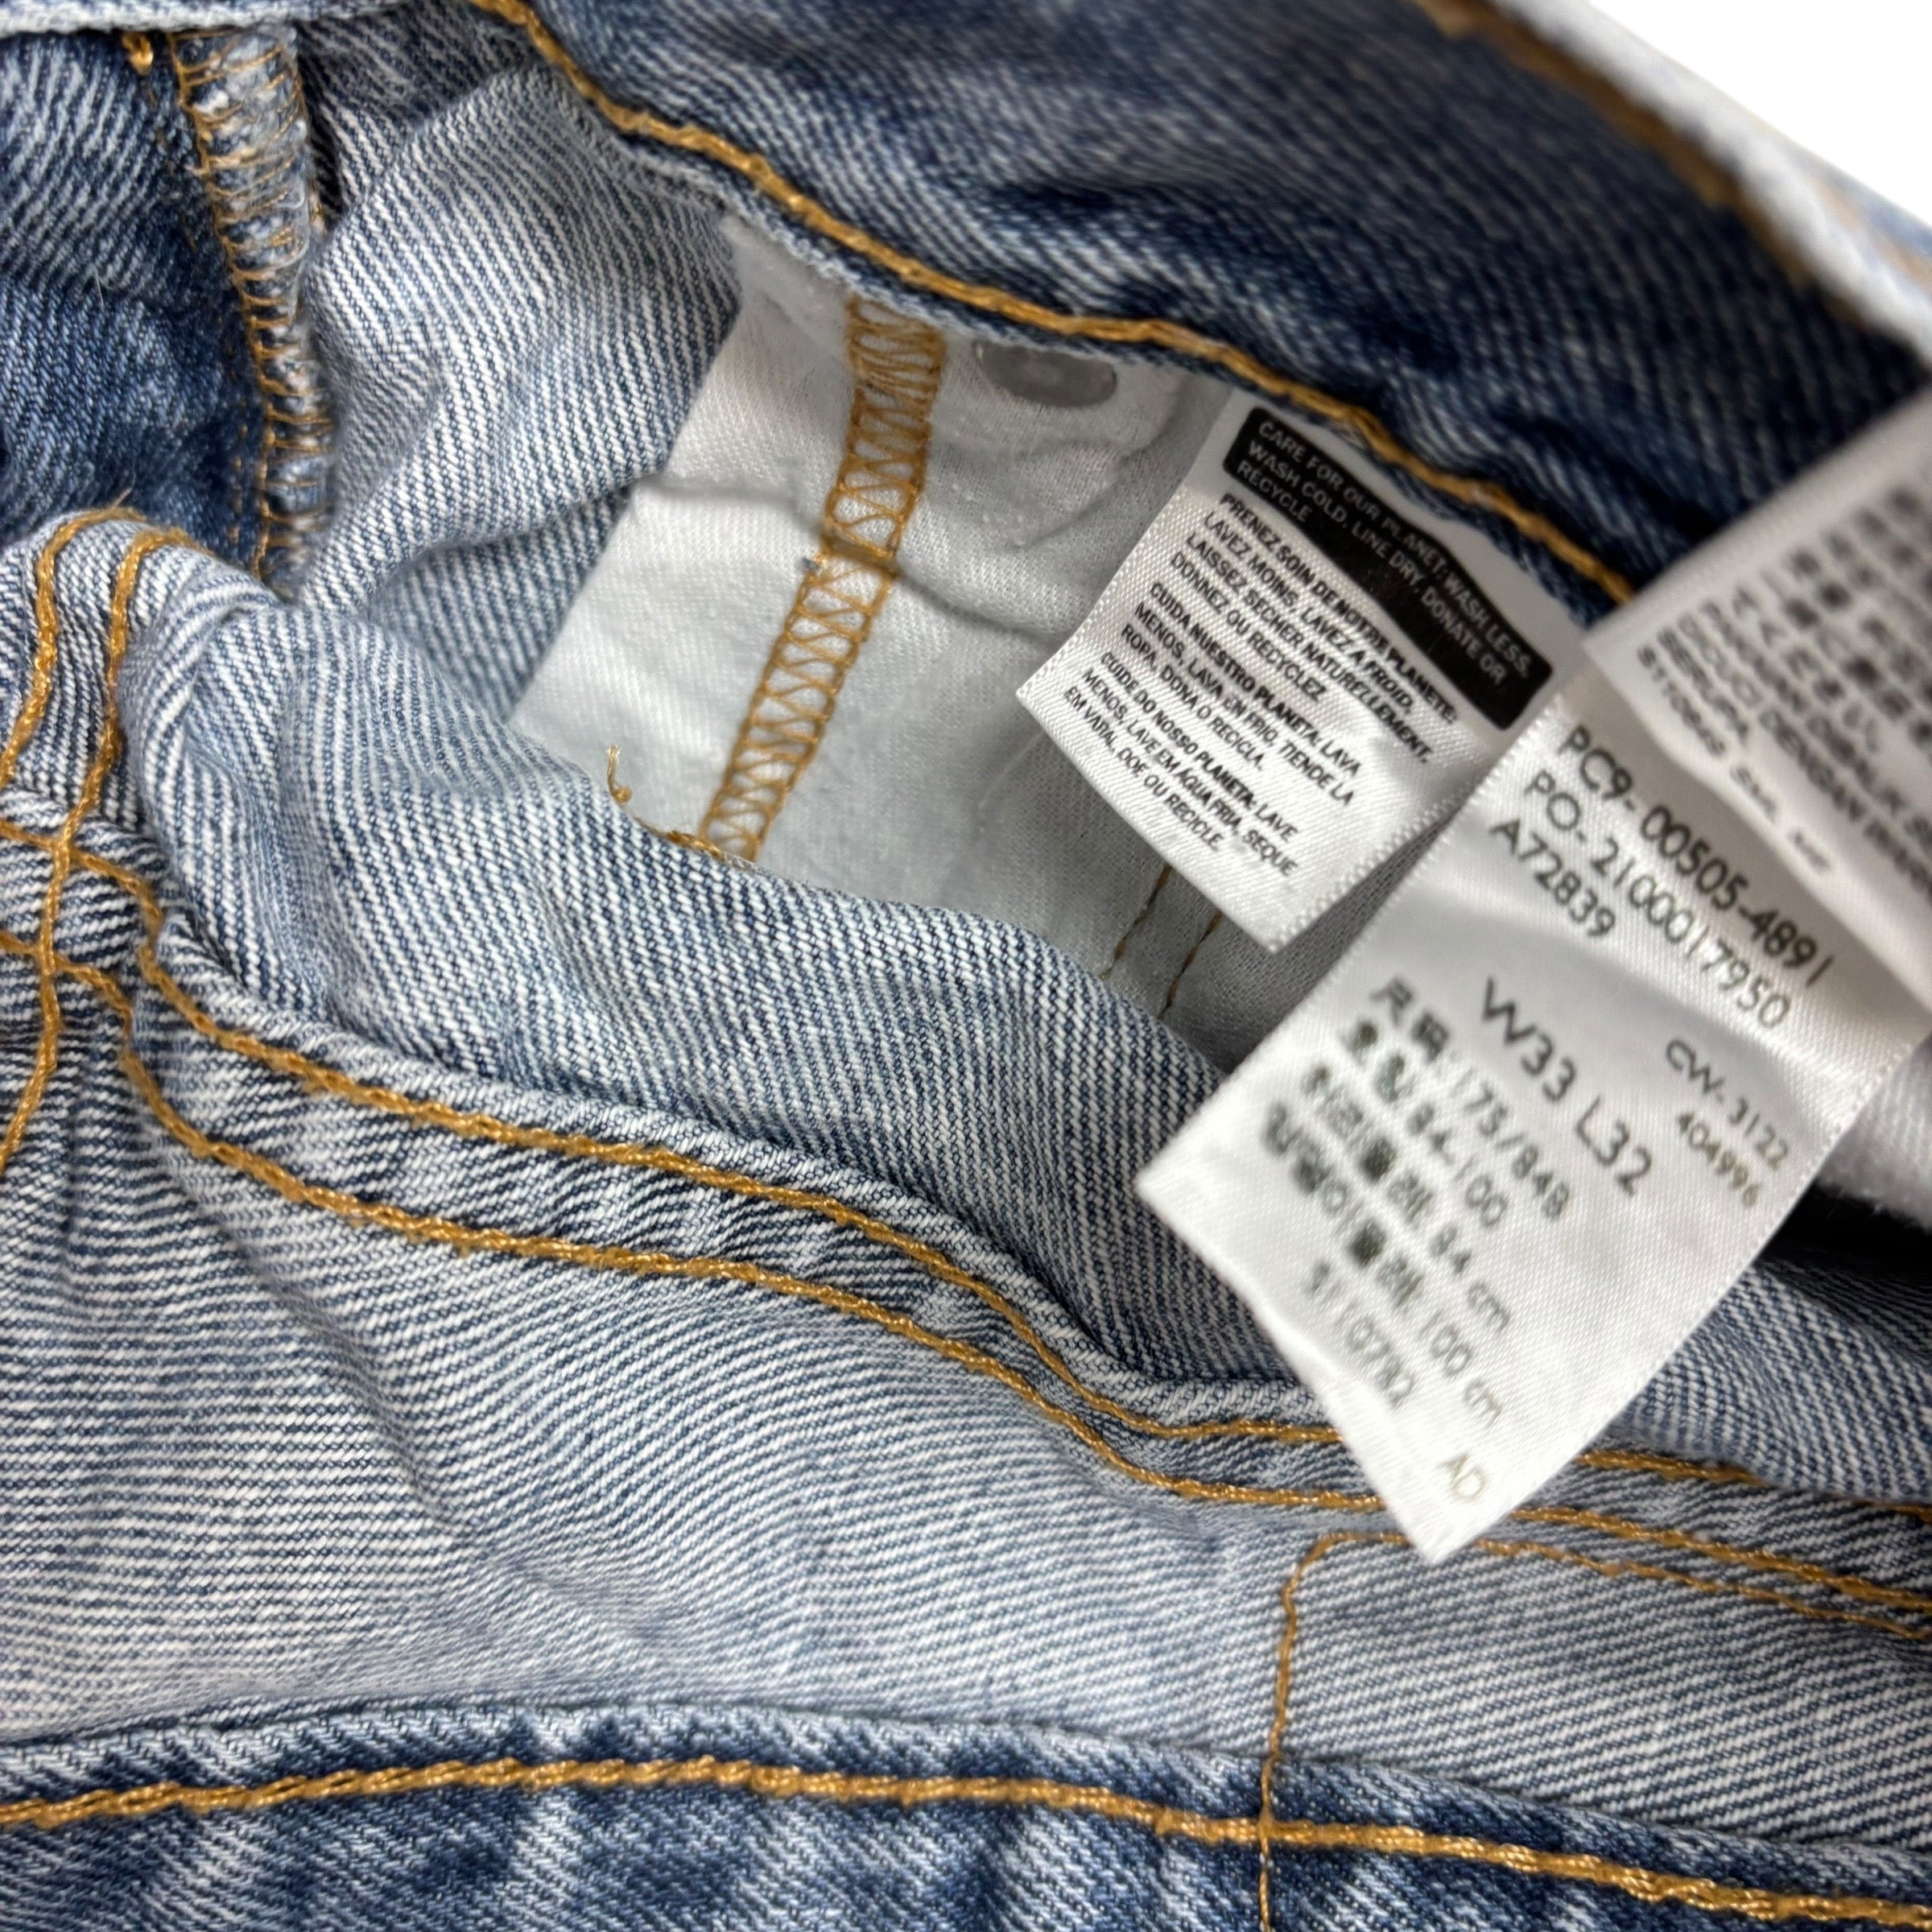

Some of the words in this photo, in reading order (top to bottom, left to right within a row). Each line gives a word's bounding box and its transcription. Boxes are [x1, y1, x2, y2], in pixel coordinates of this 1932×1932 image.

[1217, 491, 1282, 552] PRENEZ
[1274, 543, 1317, 588] SOIN
[1311, 579, 1339, 607] DE
[1333, 598, 1389, 654] NOTRE
[1235, 460, 1313, 522] RECYCLE
[1245, 439, 1302, 488] WASH
[1349, 520, 1393, 558] LINE
[1419, 585, 1484, 659] DONATE
[1476, 652, 1509, 686] OR
[1256, 419, 1309, 464] CARE
[1304, 454, 1345, 491] FOR
[1341, 485, 1381, 521] OUR
[1443, 572, 1492, 630] WASH
[1484, 622, 1538, 679] LESS,
[1169, 550, 1230, 615] DONNEZ
[1224, 607, 1252, 636] OU
[1246, 630, 1327, 701] RECYCLEZ
[1184, 531, 1248, 594] LAISSEZ
[1243, 588, 1305, 648] SECHER
[1203, 510, 1252, 560] LAVEZ
[1247, 553, 1303, 613] MOINS,
[1299, 605, 1353, 653] LAVEZ
[1099, 650, 1139, 696] CUIDE
[1133, 688, 1158, 716] DO
[1150, 708, 1199, 757] NOSSO
[1194, 749, 1259, 811] PLANETA:
[1254, 802, 1298, 843] LAVE
[1132, 601, 1190, 666] MENOS,
[1186, 658, 1227, 700] LAVA
[1221, 691, 1247, 718] EN
[1278, 739, 1334, 791] TIENDE
[1329, 781, 1355, 807] LA
[1148, 580, 1193, 629] CUIDA
[1188, 622, 1257, 694] NUESTRO
[1253, 685, 1324, 748] PLANETA:
[1319, 738, 1362, 777] LAVA
[1158, 664, 1200, 710] DONA
[1195, 704, 1212, 721] O
[1207, 715, 1269, 771] RECICLA.
[1063, 684, 1088, 712] EM
[1116, 744, 1149, 779] DOE
[1141, 771, 1169, 799] OU
[1162, 791, 1225, 852] RECICLE.
[1082, 667, 1131, 726] MENOS,
[1125, 718, 1162, 756] LAVE
[1153, 745, 1180, 774] EM
[1173, 762, 1215, 806] ÁGUA
[1241, 827, 1298, 878] SEQUE
[1488, 821, 1612, 935] A72839
[1481, 977, 1579, 1099] W33
[1573, 1095, 1651, 1195] L32
[1416, 1307, 1474, 1377] 100
[1461, 1377, 1504, 1430] cm
[1469, 1280, 1512, 1335] cm
